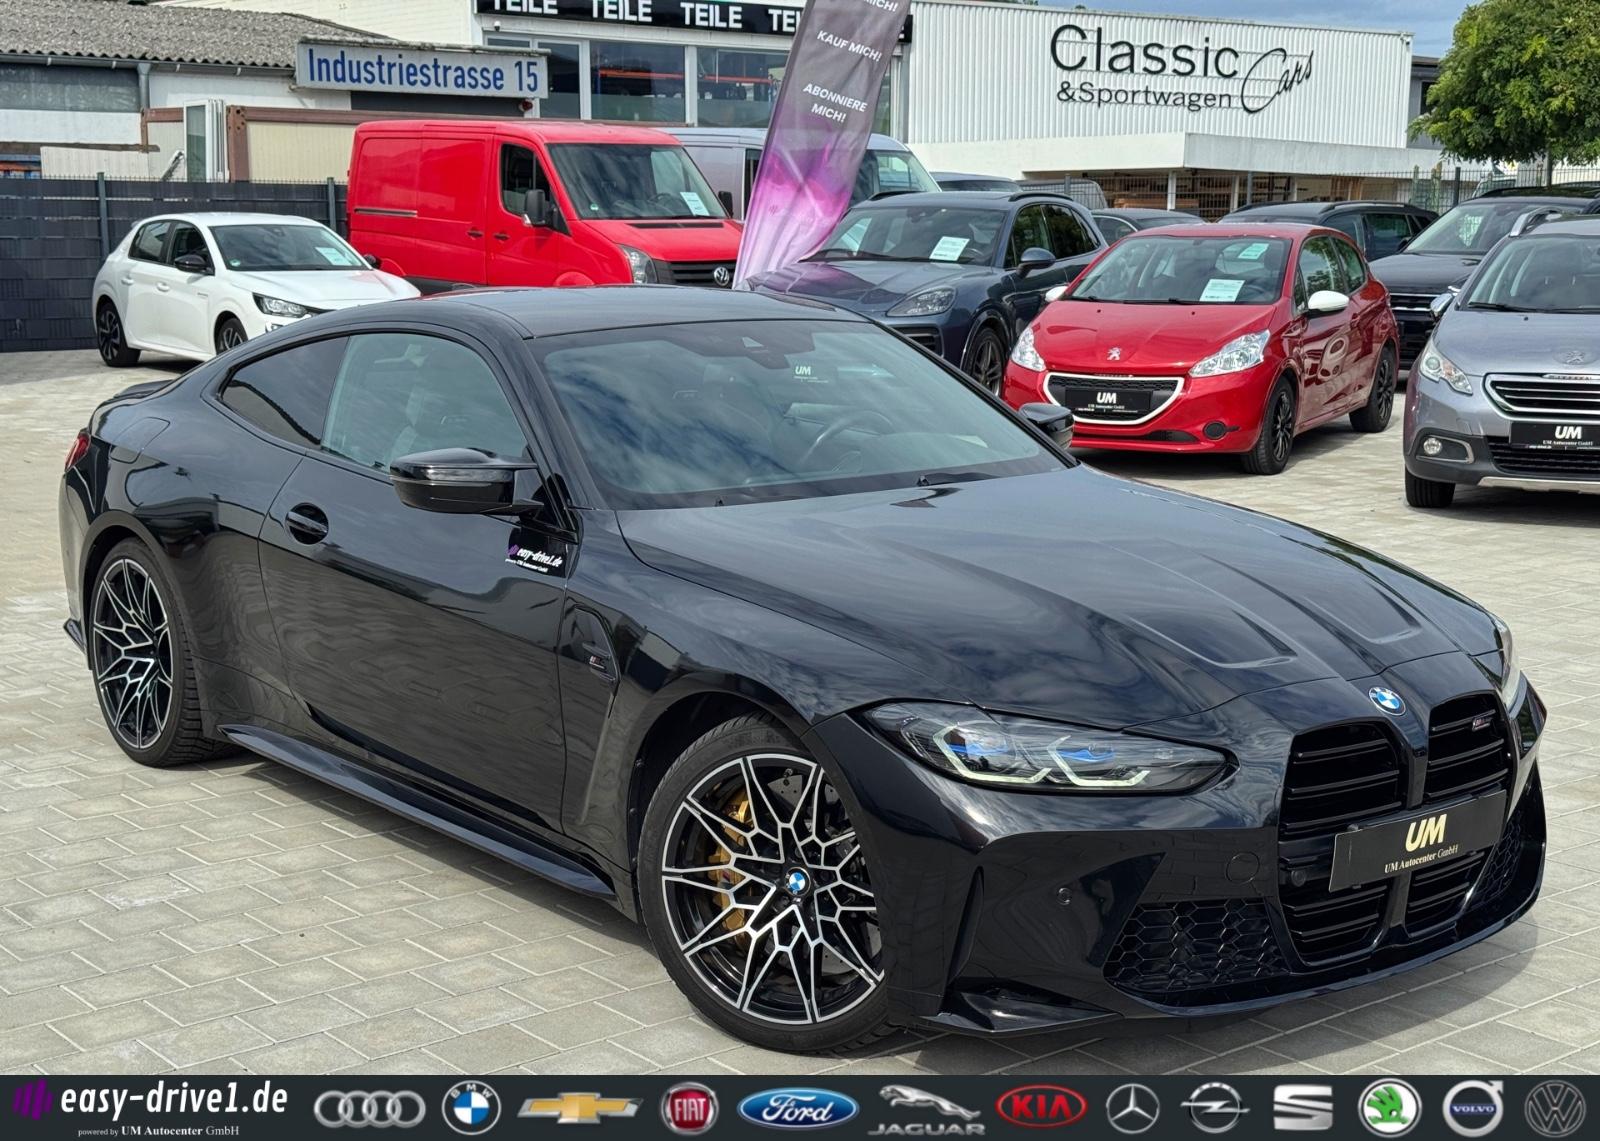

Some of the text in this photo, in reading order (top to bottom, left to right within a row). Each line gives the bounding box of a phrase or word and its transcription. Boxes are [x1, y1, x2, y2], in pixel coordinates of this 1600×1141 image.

[591, 0, 652, 22] TEILE
[680, 2, 742, 29] TEILE
[817, 30, 882, 62] KAUF MICH!
[308, 48, 538, 92] Industriestrasse 15
[1050, 24, 1314, 114] Classic Cars
[803, 83, 868, 113] ABONNIERE
[1057, 80, 1232, 112] &Sportwagen
[811, 103, 847, 123] MICH!
[795, 366, 811, 375] UM
[1096, 392, 1117, 404] UM
[1555, 426, 1582, 439] UM
[1405, 813, 1447, 852] UM
[1384, 844, 1459, 873] UM Autocenter GmbH
